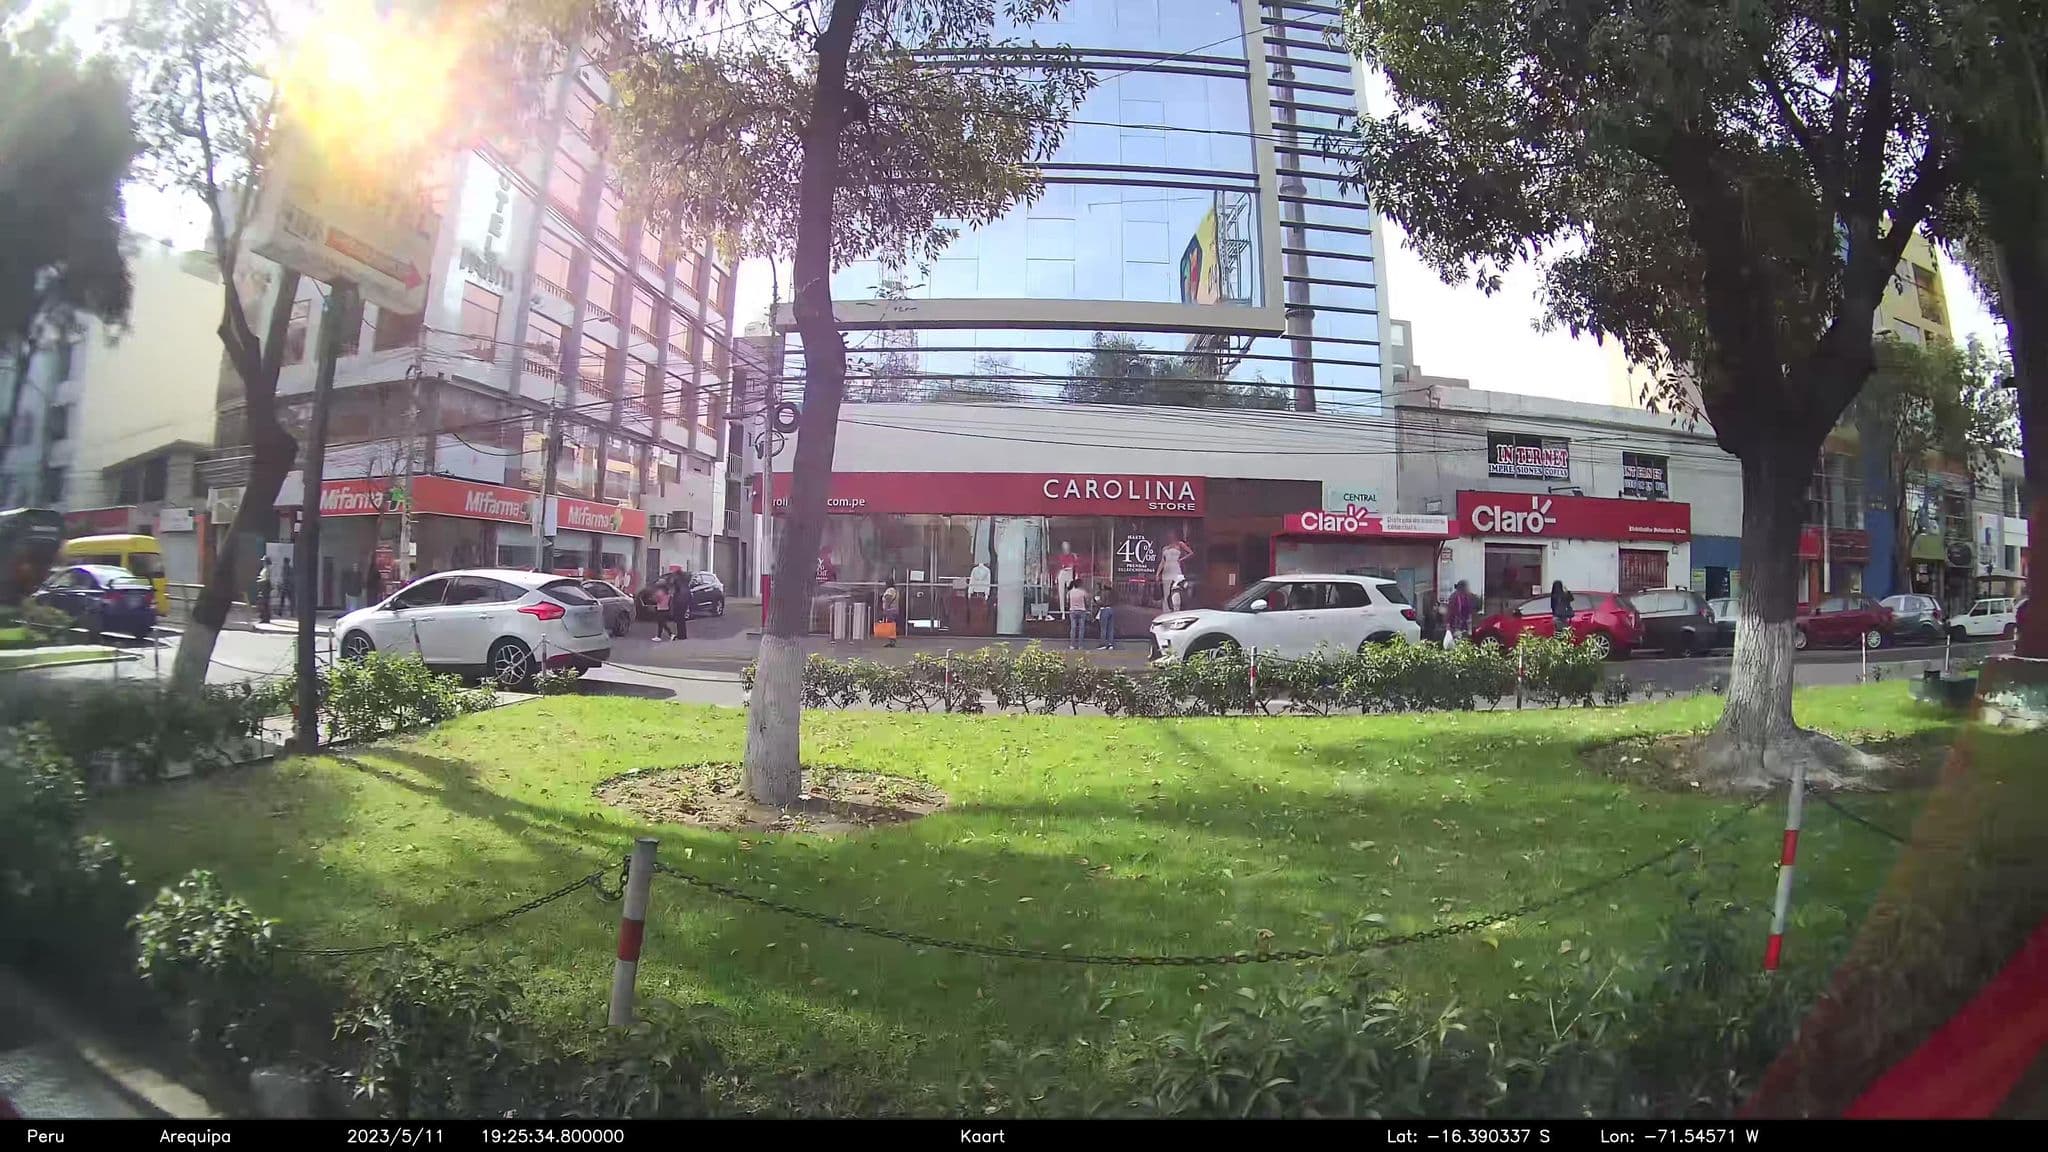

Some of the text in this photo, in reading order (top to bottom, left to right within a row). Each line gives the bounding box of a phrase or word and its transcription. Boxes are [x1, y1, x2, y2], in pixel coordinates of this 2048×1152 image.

[1496, 444, 1569, 468] INTERNET
[319, 486, 384, 511] Mifarma
[1043, 479, 1196, 501] CAROLINA
[1343, 493, 1377, 502] CENTRAL
[465, 490, 521, 518] Mifarma
[827, 497, 865, 508] com.pe
[1149, 502, 1196, 511] STORE
[568, 505, 610, 527] Mifarma
[1301, 511, 1359, 533] Claro
[1471, 504, 1544, 533] Claro
